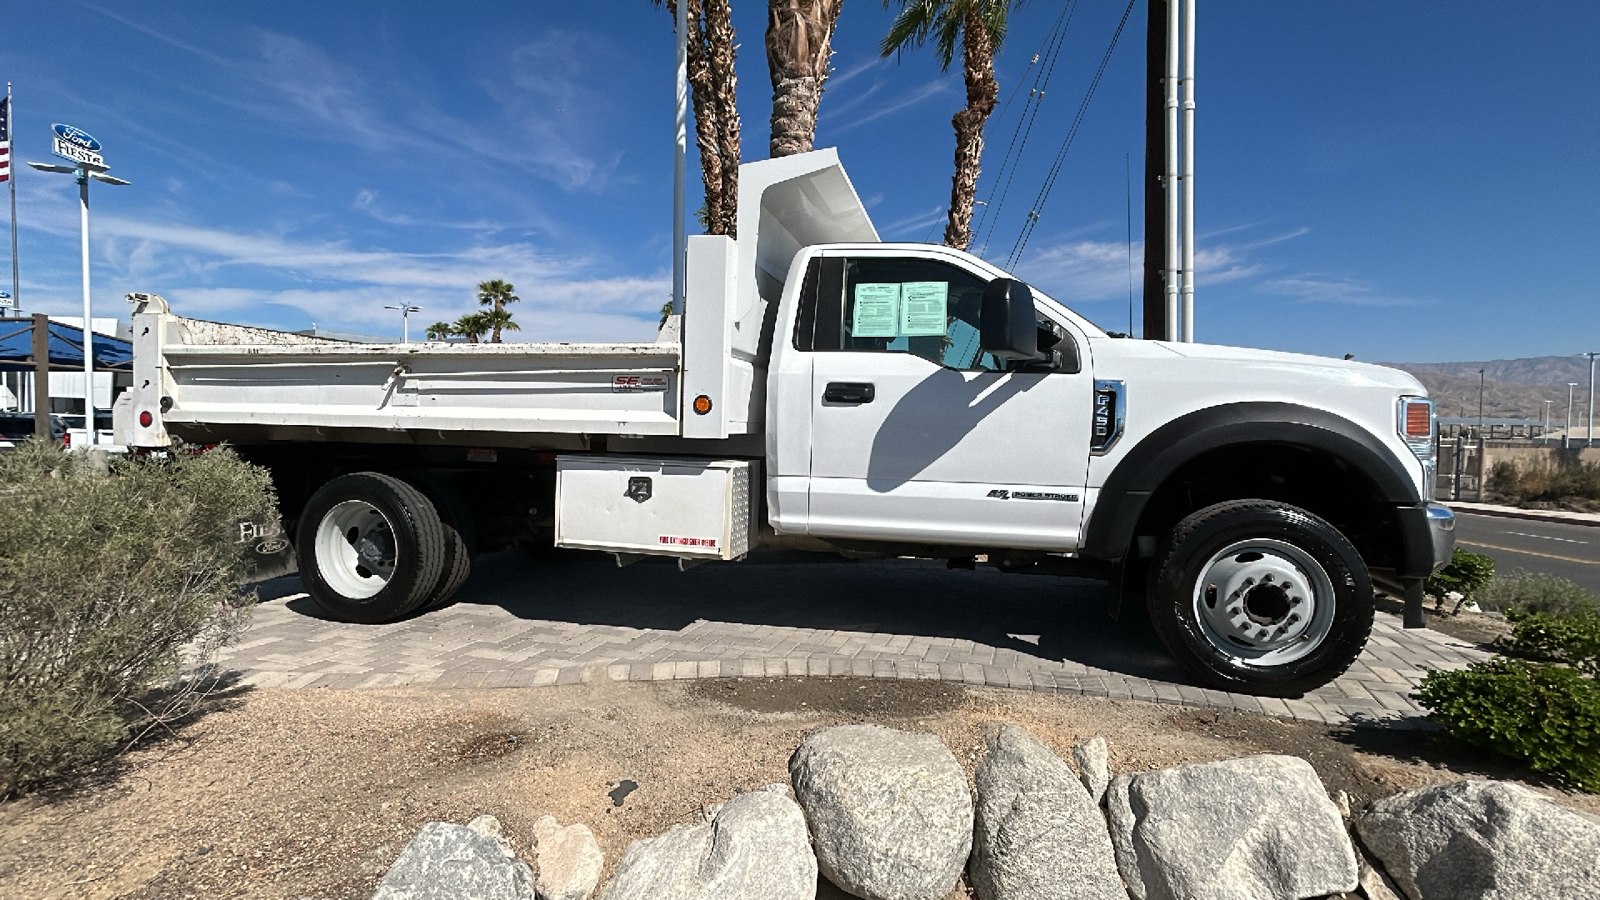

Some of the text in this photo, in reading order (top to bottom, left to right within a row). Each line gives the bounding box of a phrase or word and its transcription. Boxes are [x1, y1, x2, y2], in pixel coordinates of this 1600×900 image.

[62, 127, 93, 148] Ford
[57, 139, 101, 164] FIESTA
[1014, 491, 1042, 499] POWER
[1044, 493, 1078, 501] STROKE
[659, 536, 669, 544] FIRE
